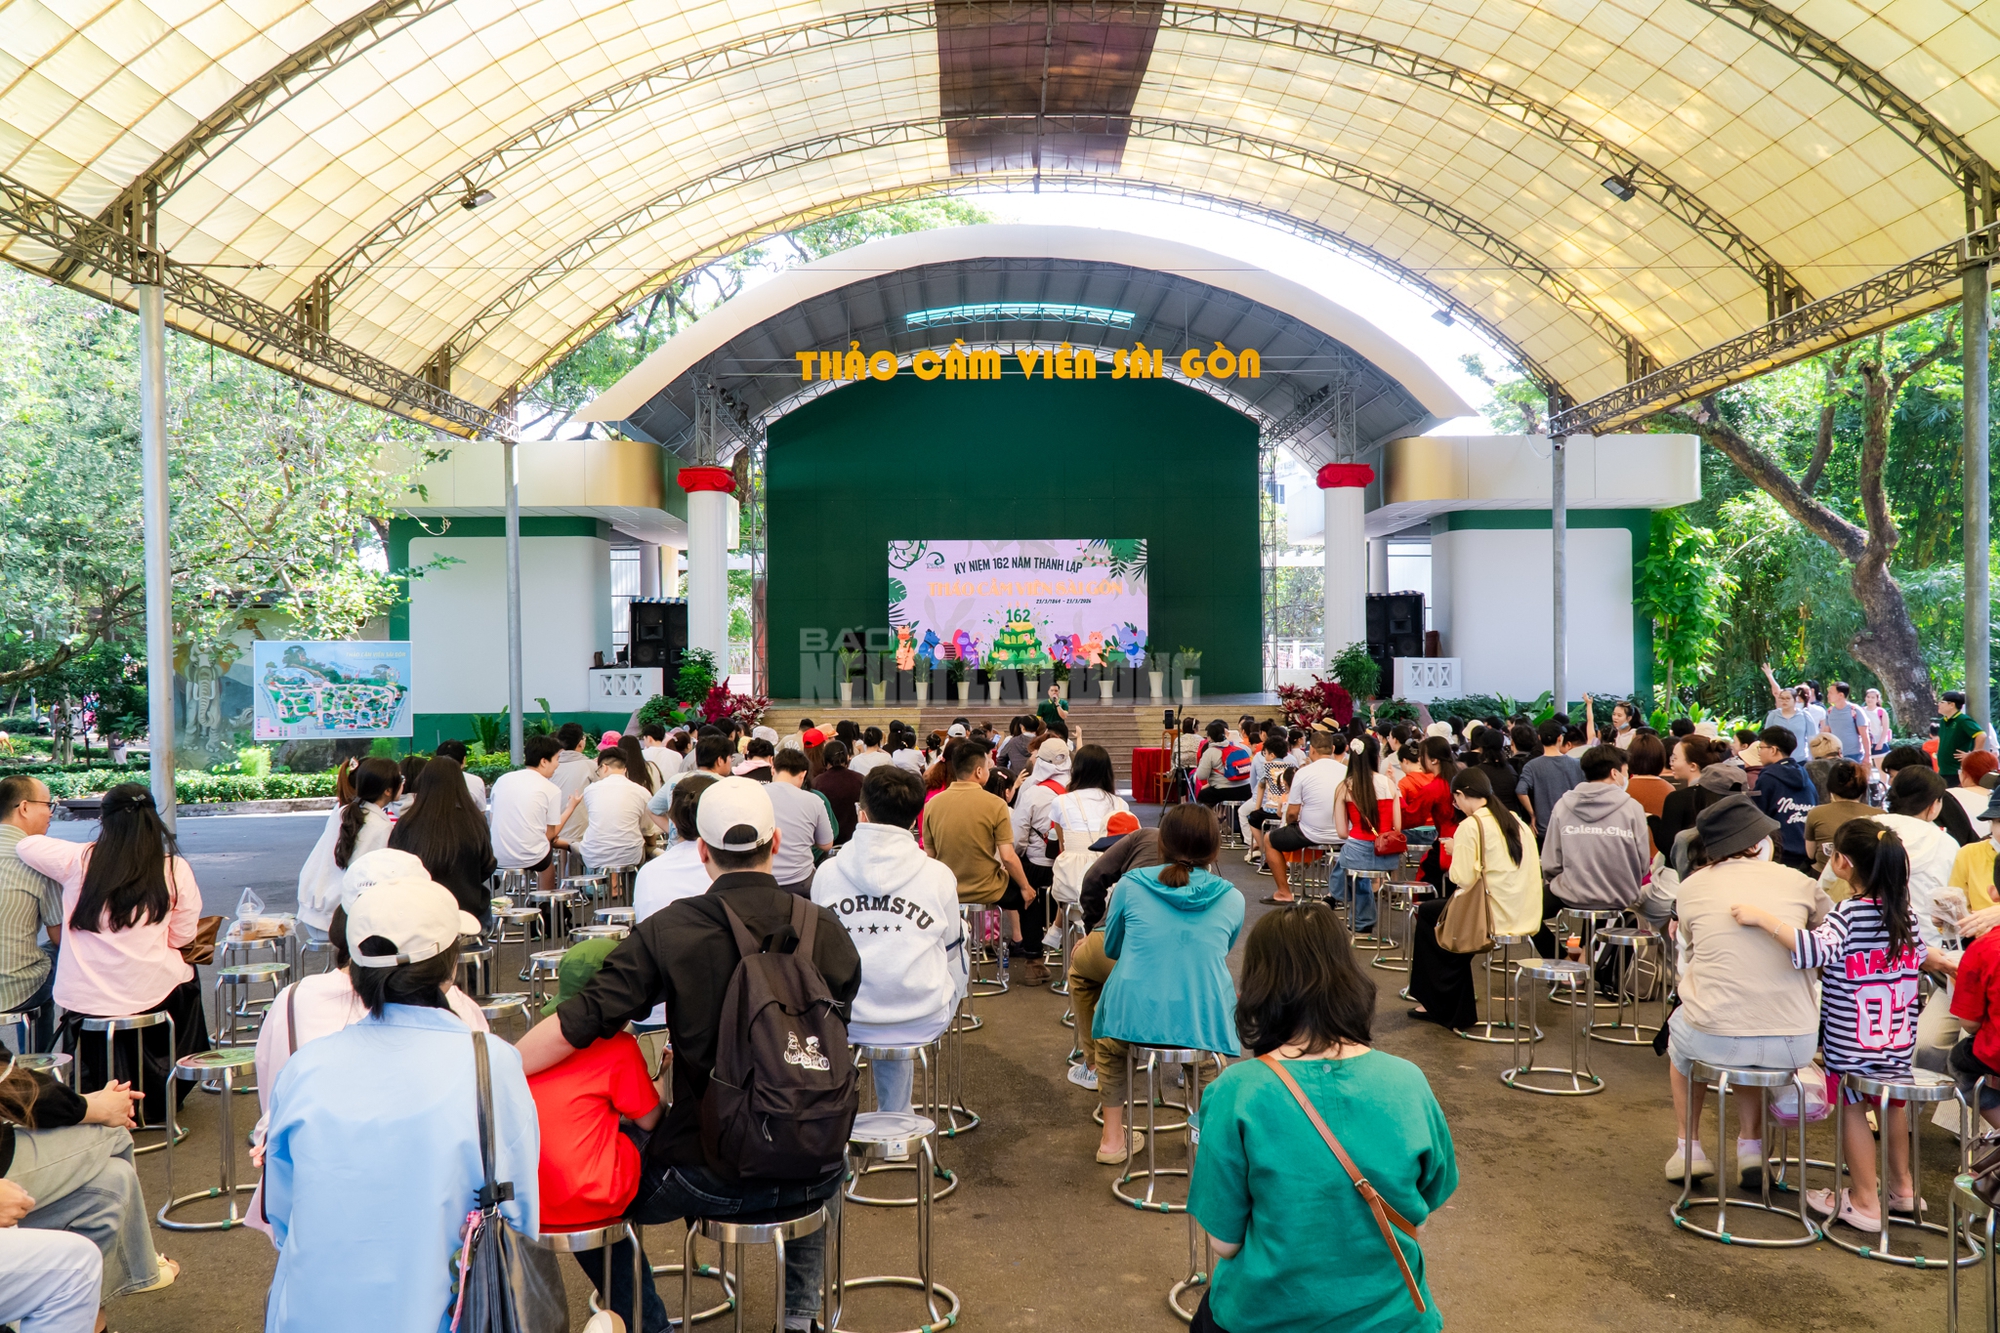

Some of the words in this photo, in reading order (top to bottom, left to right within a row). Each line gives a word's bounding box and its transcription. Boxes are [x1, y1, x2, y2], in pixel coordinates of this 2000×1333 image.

[1112, 342, 1163, 379] SÀI
[992, 557, 1010, 569] 162
[1006, 608, 1031, 623] 162
